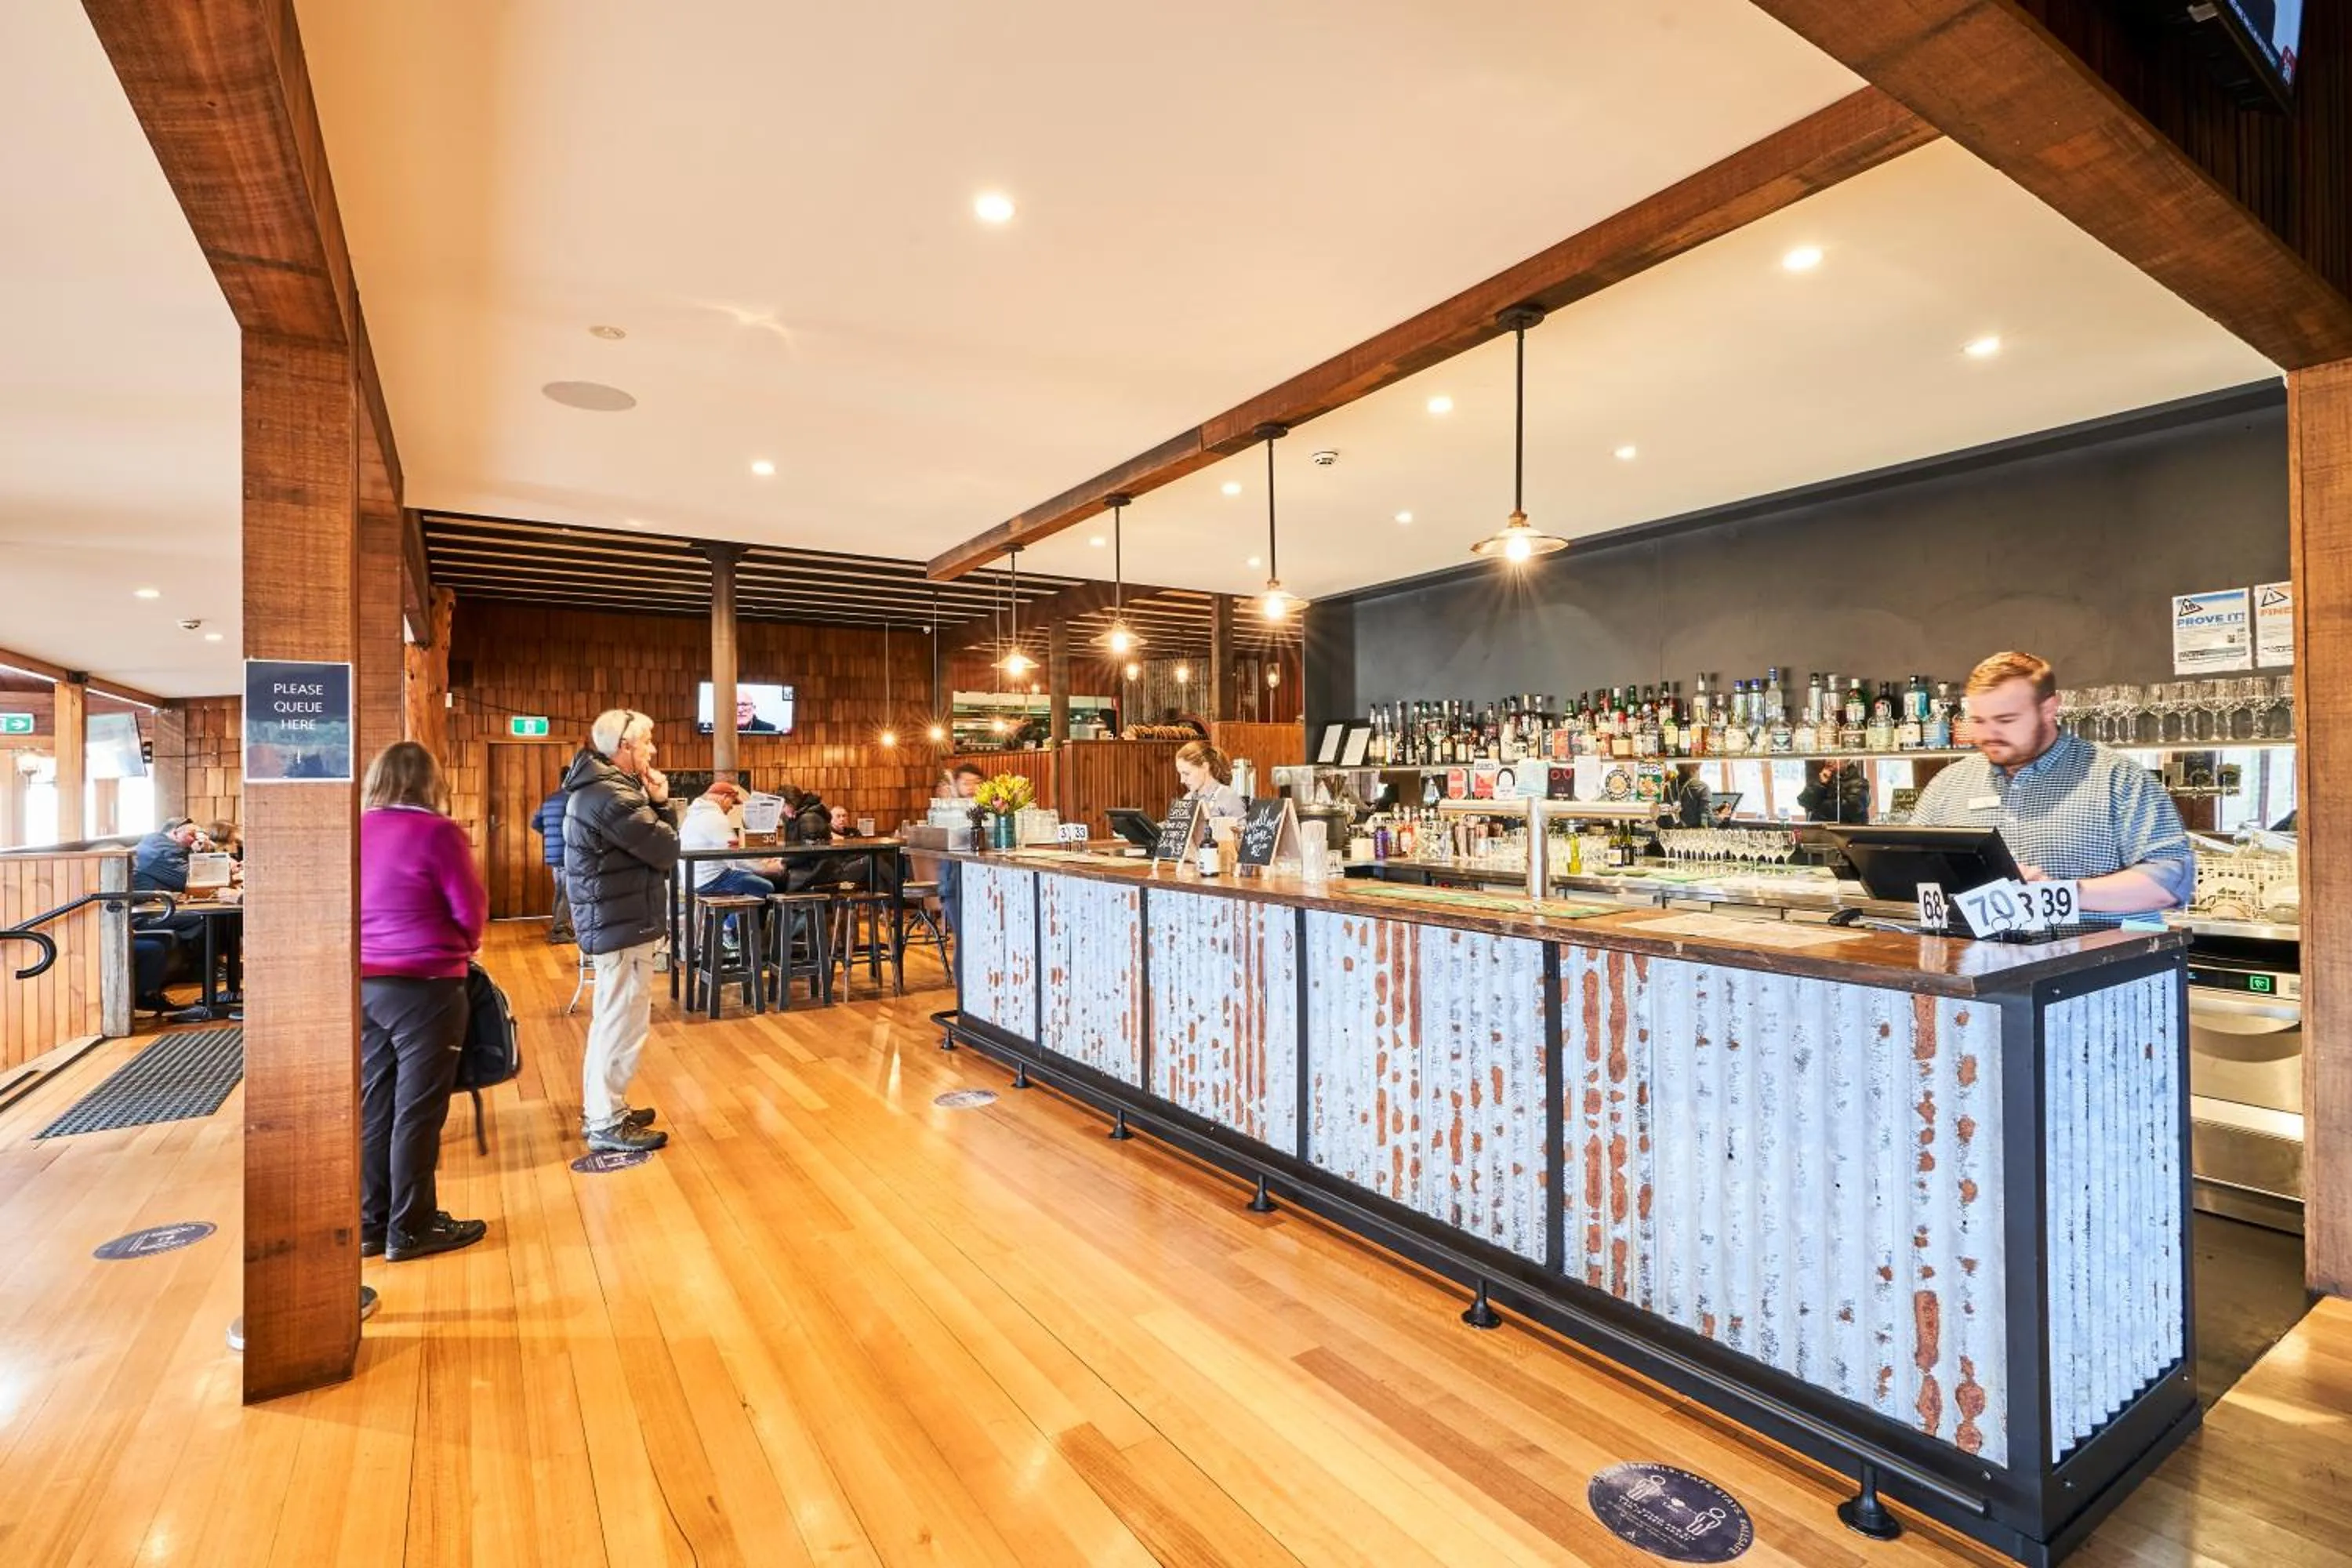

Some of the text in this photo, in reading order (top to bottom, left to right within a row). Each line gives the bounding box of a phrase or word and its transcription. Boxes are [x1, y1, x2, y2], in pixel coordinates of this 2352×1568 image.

[2176, 614, 2223, 626] PROVE
[274, 683, 324, 695] PLEASE
[274, 701, 324, 713] QUEUE
[281, 719, 316, 730] HERE
[1923, 890, 1943, 920] 68
[1967, 889, 2016, 928] 70
[2017, 892, 2034, 920] 3
[2041, 887, 2072, 917] 39
